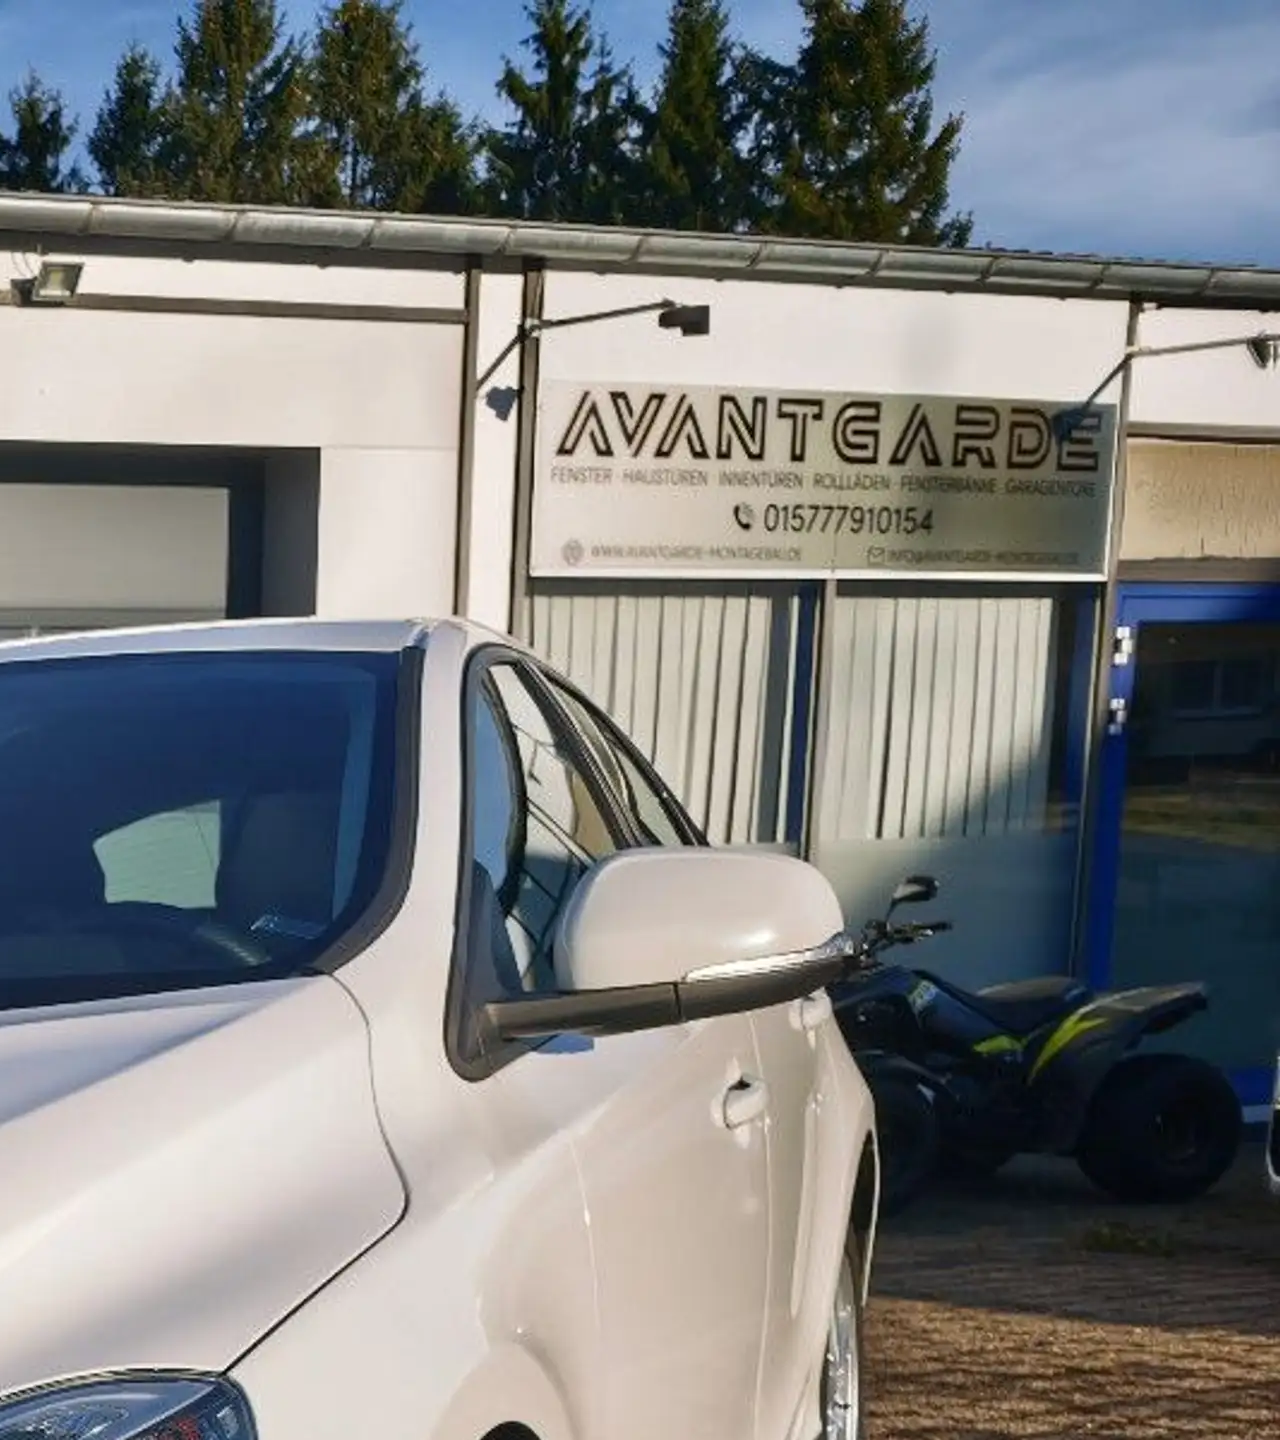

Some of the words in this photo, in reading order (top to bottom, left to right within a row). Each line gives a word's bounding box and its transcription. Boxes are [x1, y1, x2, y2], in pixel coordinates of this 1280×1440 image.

[556, 390, 1103, 472] AVANTGARDE
[550, 465, 613, 486] FENSTER
[764, 503, 936, 535] 015777910154
